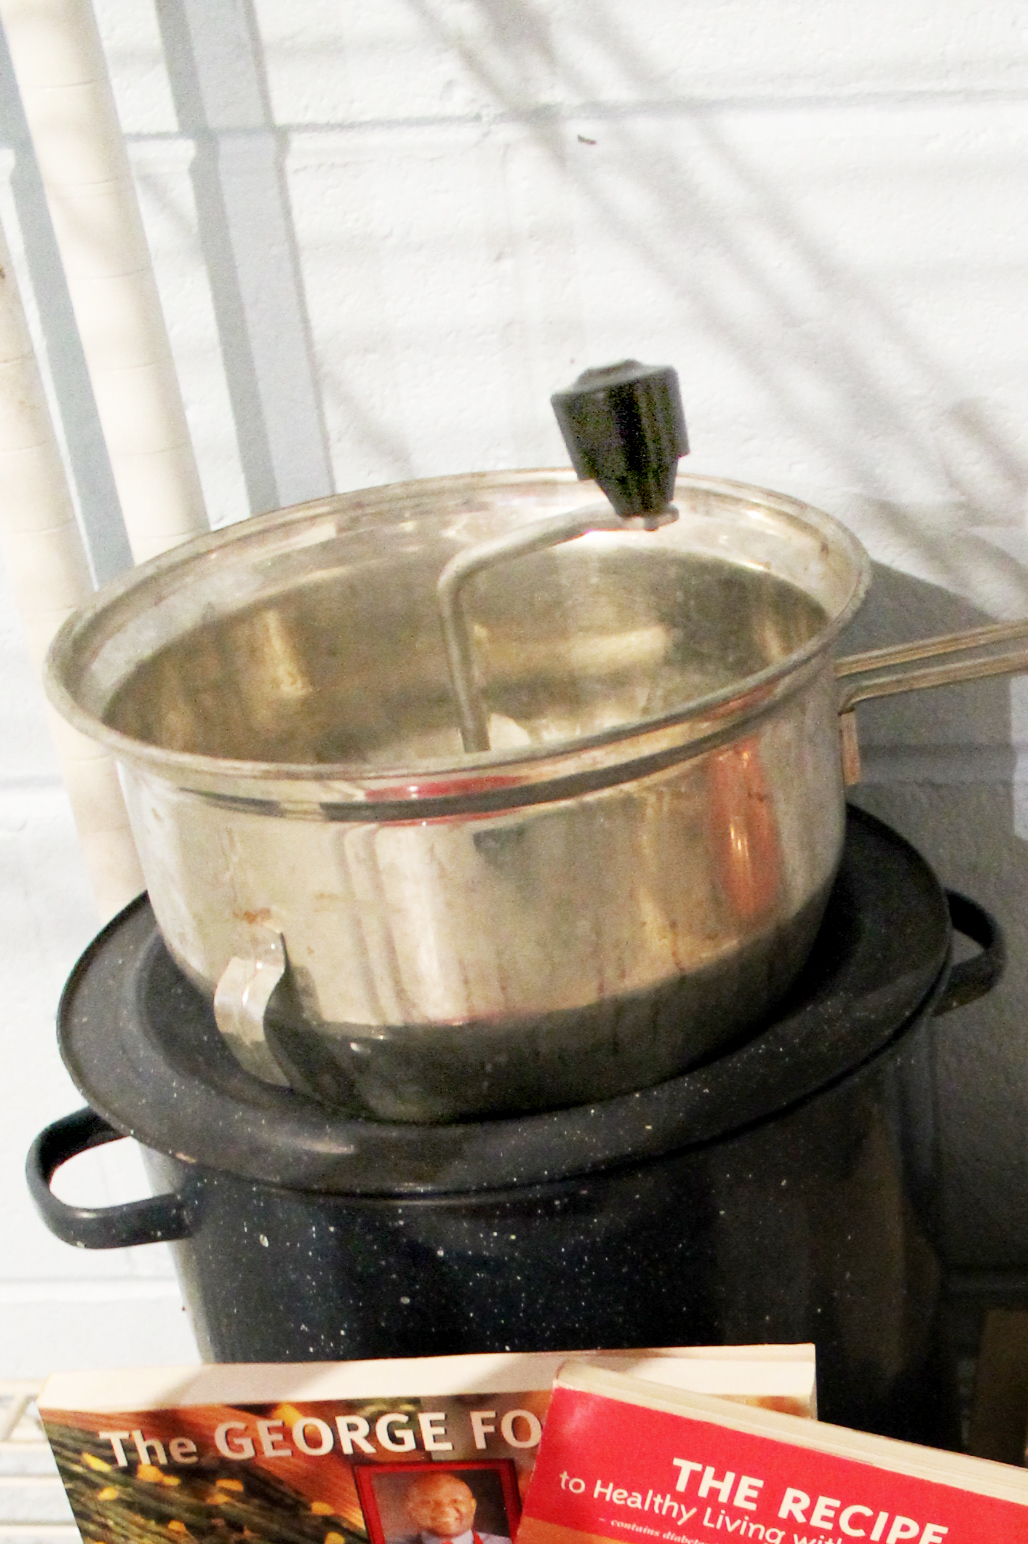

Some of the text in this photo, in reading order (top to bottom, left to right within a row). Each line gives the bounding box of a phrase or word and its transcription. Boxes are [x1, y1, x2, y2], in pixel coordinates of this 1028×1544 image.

[98, 1431, 197, 1467] The
[215, 1412, 453, 1461] GEORGE
[559, 1471, 585, 1494] to
[593, 1480, 697, 1525] Healthy
[672, 1457, 764, 1511] THE
[610, 1519, 660, 1537] contains
